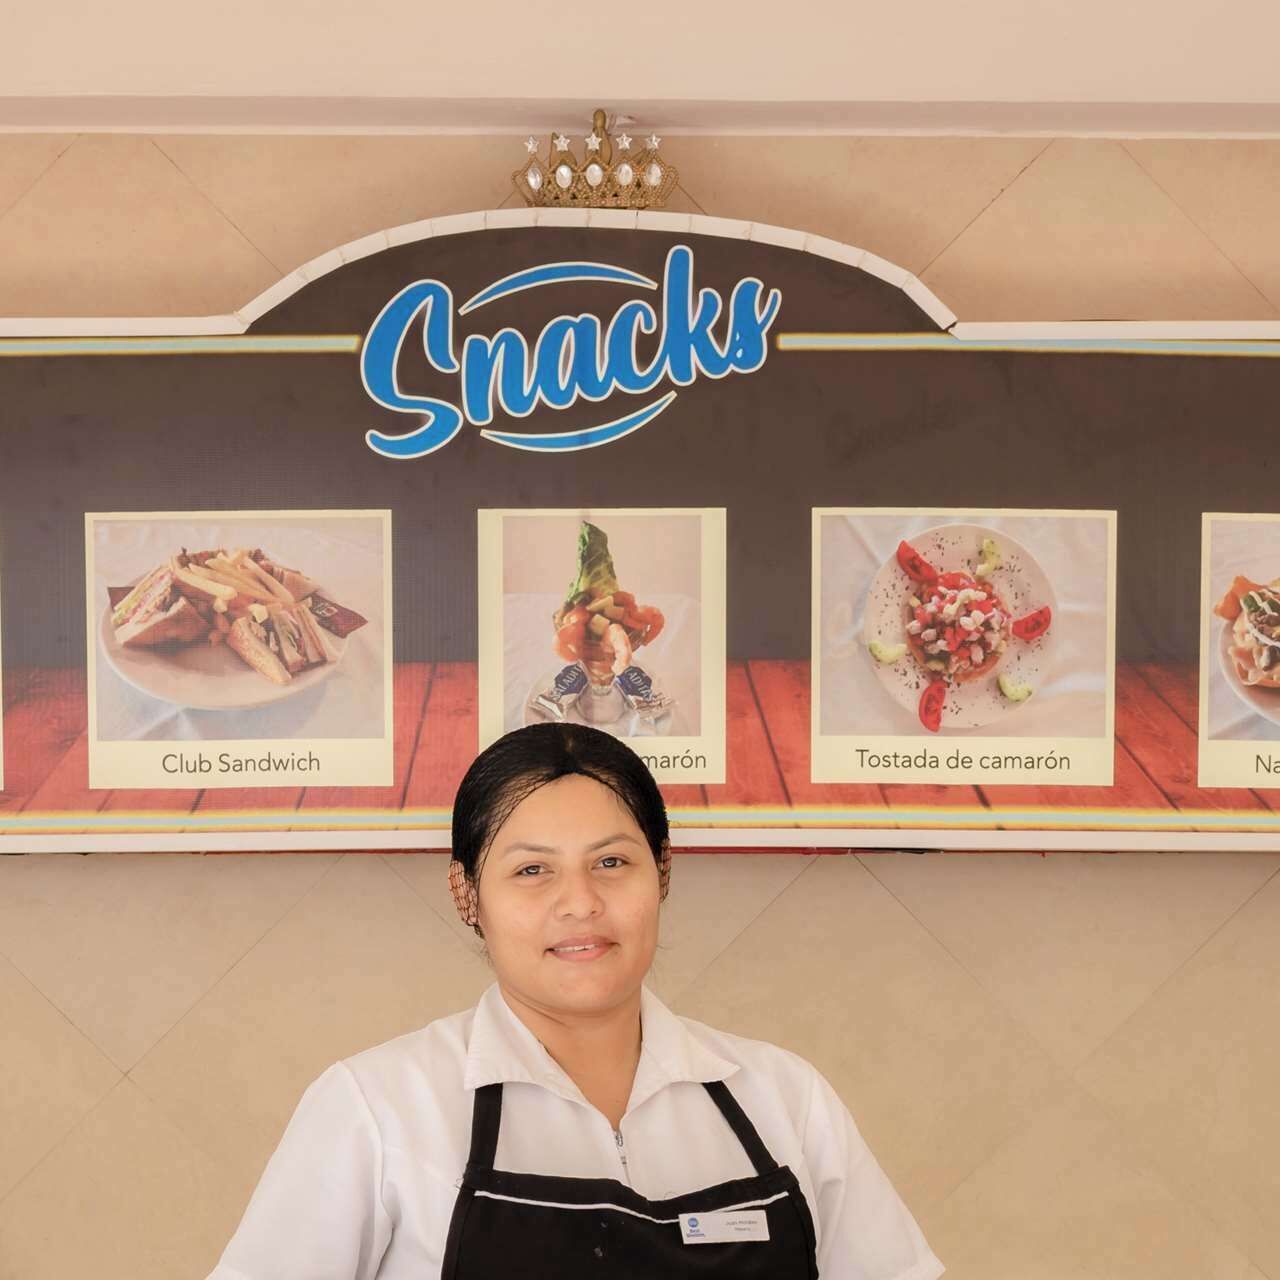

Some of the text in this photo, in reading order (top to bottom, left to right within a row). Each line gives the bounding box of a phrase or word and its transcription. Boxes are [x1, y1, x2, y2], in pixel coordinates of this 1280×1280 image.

[361, 245, 782, 459] Snacks
[162, 751, 320, 773] Club Sandwich
[640, 749, 706, 769] marón
[855, 748, 1071, 770] Tostada de camarón
